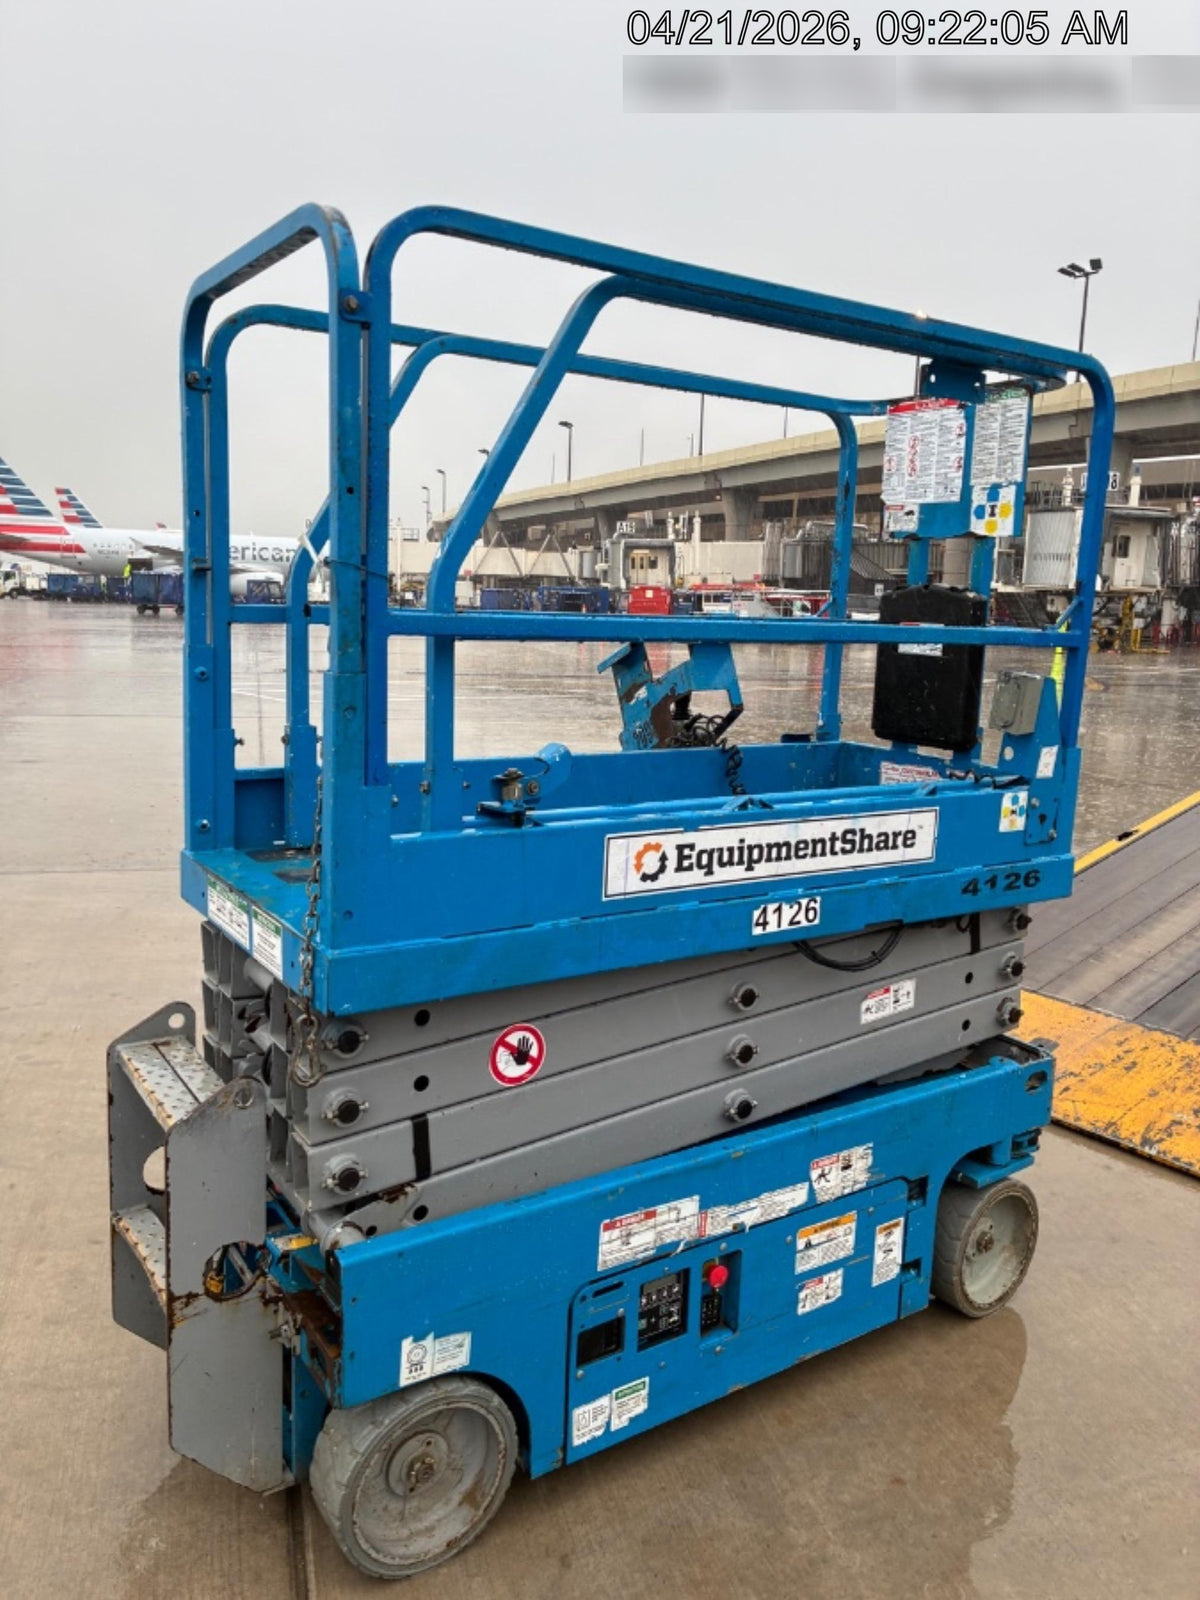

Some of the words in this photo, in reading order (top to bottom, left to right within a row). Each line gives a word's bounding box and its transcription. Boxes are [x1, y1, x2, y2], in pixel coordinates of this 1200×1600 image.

[674, 828, 917, 877] EquipmentShare
[960, 869, 1042, 897] 4126
[753, 897, 819, 932] 4126
